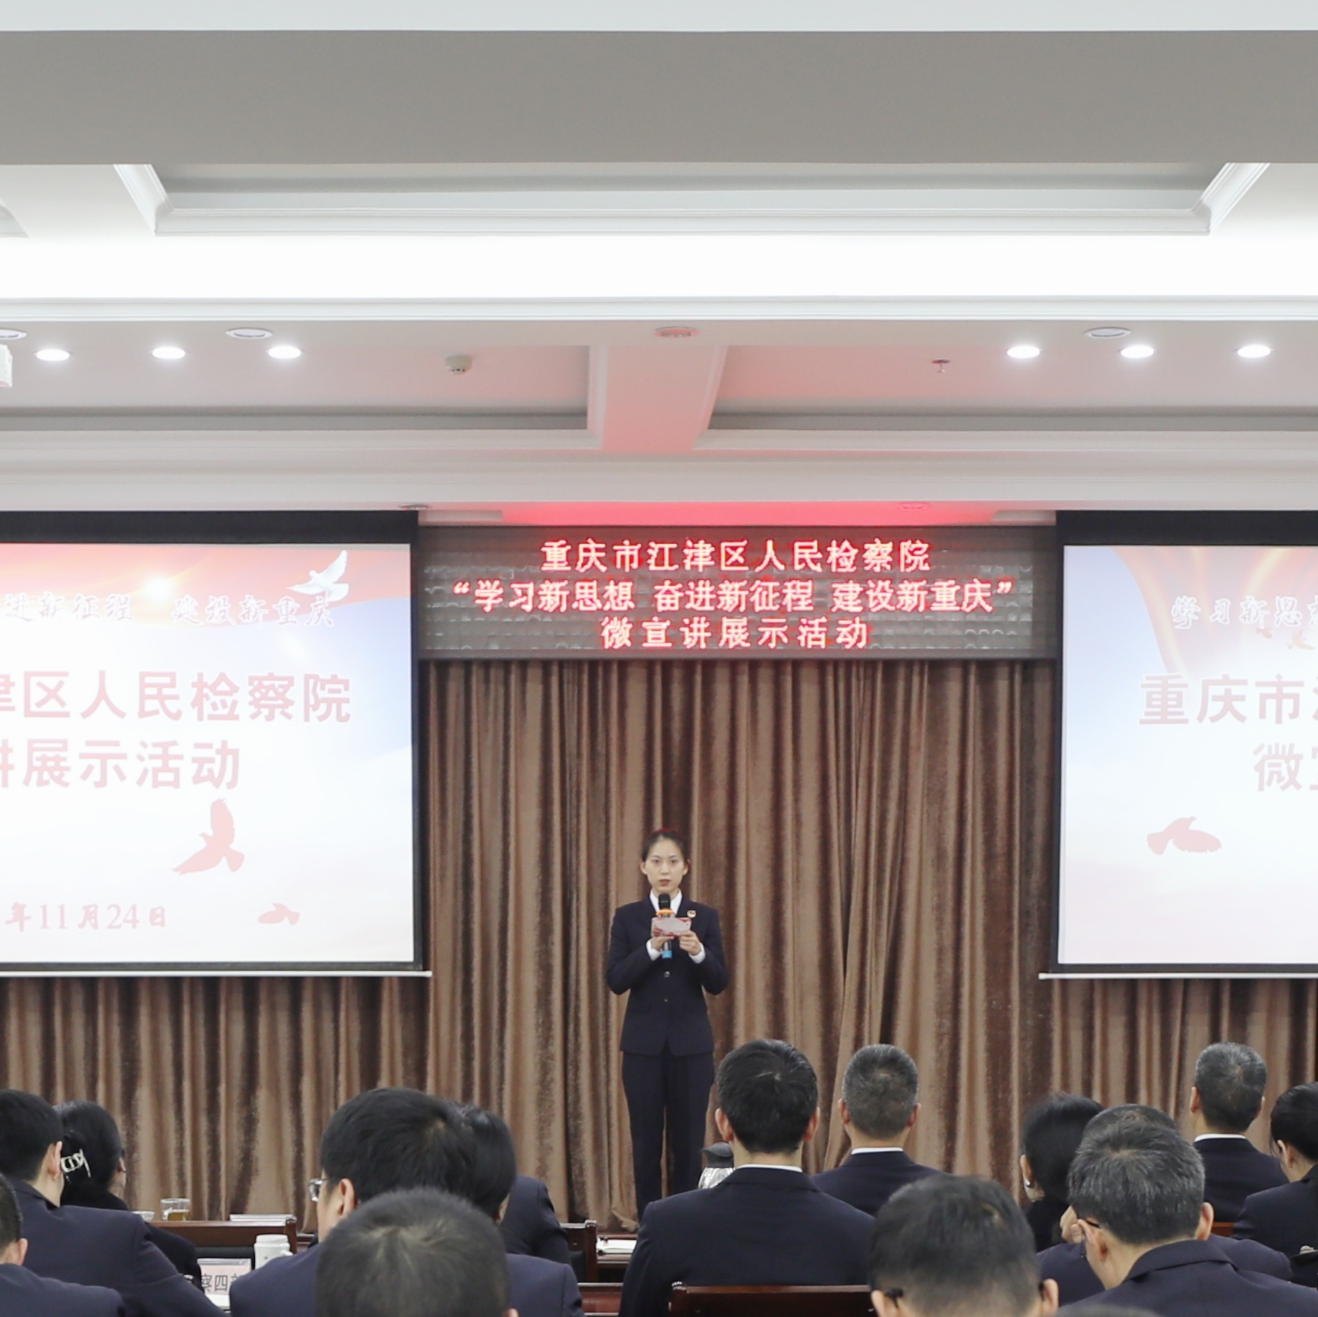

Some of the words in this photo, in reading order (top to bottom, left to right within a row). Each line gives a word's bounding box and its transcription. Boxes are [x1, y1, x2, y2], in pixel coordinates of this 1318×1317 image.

[540, 539, 931, 574] 重庆市江津区人民检察院
[653, 579, 815, 613] 奋进新征程
[600, 616, 870, 651] 微宣讲展示活动
